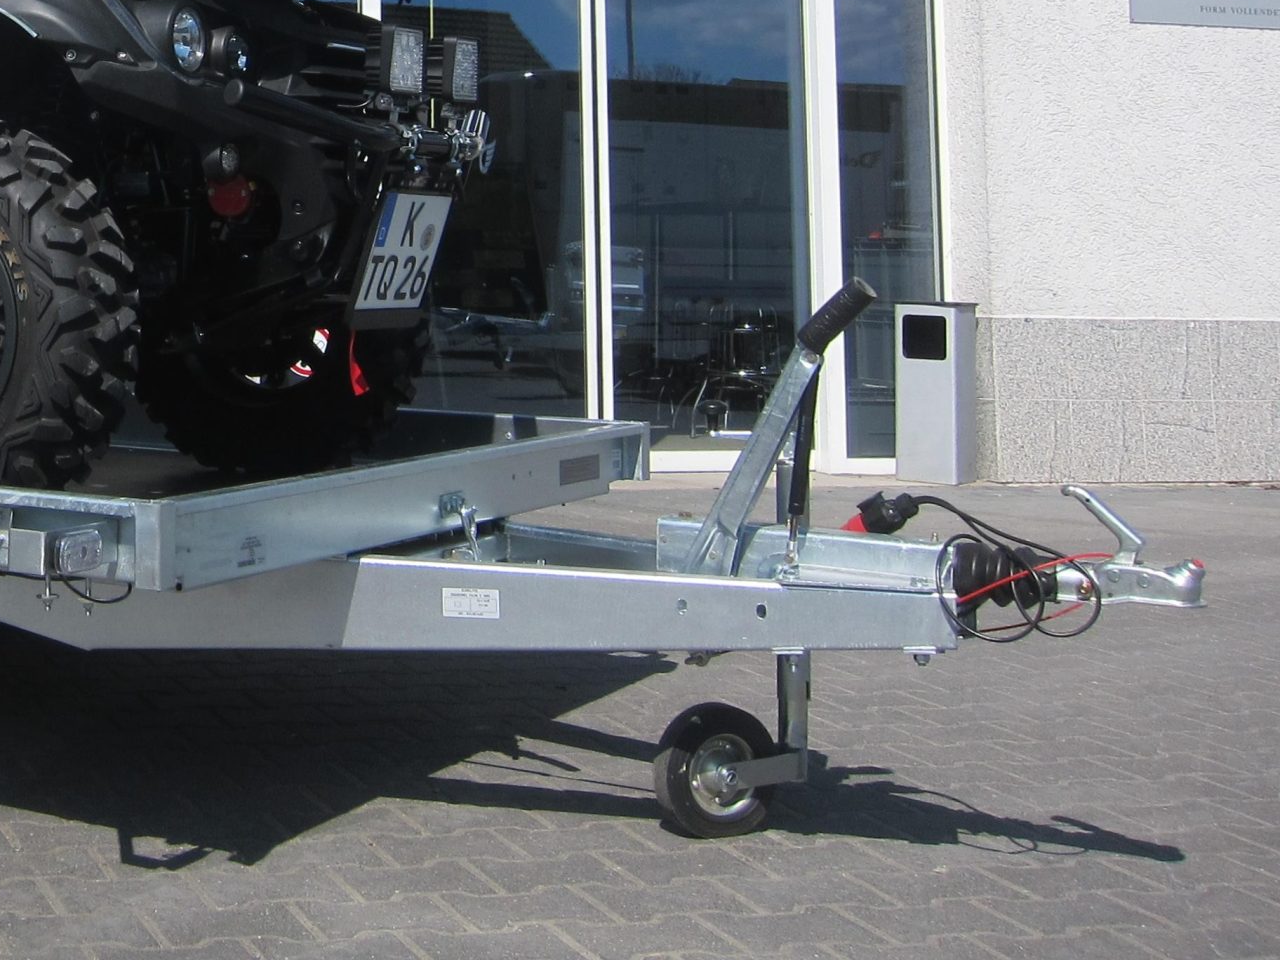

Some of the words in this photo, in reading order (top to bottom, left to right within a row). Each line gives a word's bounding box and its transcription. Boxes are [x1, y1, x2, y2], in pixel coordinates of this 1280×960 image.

[1199, 5, 1227, 14] FORM
[1230, 6, 1280, 17] VOLLENDE
[400, 201, 426, 247] K
